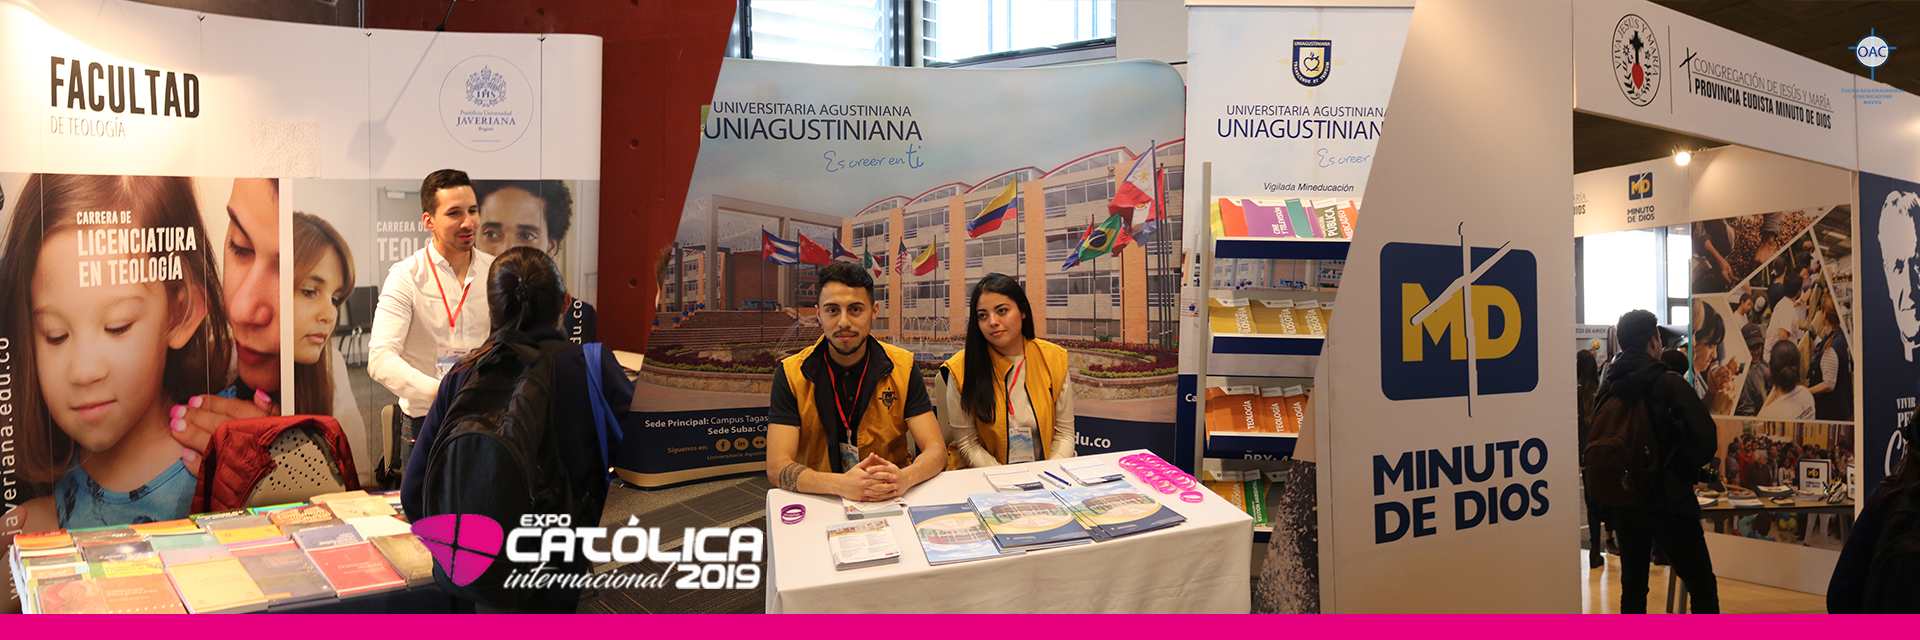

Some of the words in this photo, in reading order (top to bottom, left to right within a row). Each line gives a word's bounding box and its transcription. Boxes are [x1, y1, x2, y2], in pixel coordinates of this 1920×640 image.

[1618, 16, 1639, 38] JESÚS
[1642, 24, 1647, 33] Y
[1646, 34, 1658, 76] MARÍA
[51, 56, 200, 118] FACULTAD
[1694, 58, 1765, 90] CONGREGACIÓN
[1766, 80, 1778, 94] DE
[1780, 83, 1800, 101] JESÚS
[1802, 90, 1808, 102] Y
[1808, 93, 1832, 109] MARÍA
[713, 101, 816, 115] UNIVERSITARIA
[820, 104, 912, 117] AGUSTINIANA
[1226, 105, 1310, 116] UNIVERSITARIA
[1695, 78, 1740, 106] PROVINCIA
[1742, 91, 1774, 115] EUDISTA
[1776, 100, 1804, 122] MINUTO
[1806, 108, 1815, 125] DE
[1816, 112, 1832, 129] DIOS
[51, 116, 64, 134] DE
[68, 116, 126, 138] TEOLOGÍA
[456, 116, 516, 127] JAVERIANA
[704, 117, 922, 141] UNIAGUSTINIANA
[824, 150, 845, 172] Es
[849, 157, 886, 169] creer
[1264, 182, 1295, 192] Vigilada
[1298, 182, 1354, 192] Mineducación
[76, 211, 118, 224] CARRERA
[120, 210, 132, 224] DE
[1324, 207, 1338, 236] PÚBLICA
[1627, 205, 1655, 215] MINUTO
[1639, 213, 1655, 222] DIOS
[376, 221, 416, 232] CARRERA
[78, 226, 196, 256] LICENCIATURA
[79, 261, 102, 288] EN
[108, 252, 182, 285] TEOLOGÍA
[1402, 283, 1522, 362] MD
[1896, 396, 1916, 409] VIVIR
[668, 417, 709, 427] Principal:
[710, 416, 744, 425] Campus
[1243, 400, 1255, 429] TEOLOGÍA
[1271, 403, 1284, 432] TEOLOGÍA
[708, 427, 729, 435] Sede
[1372, 437, 1548, 496] MINUTO
[1374, 496, 1436, 545] DE
[1454, 480, 1549, 530] DIOS
